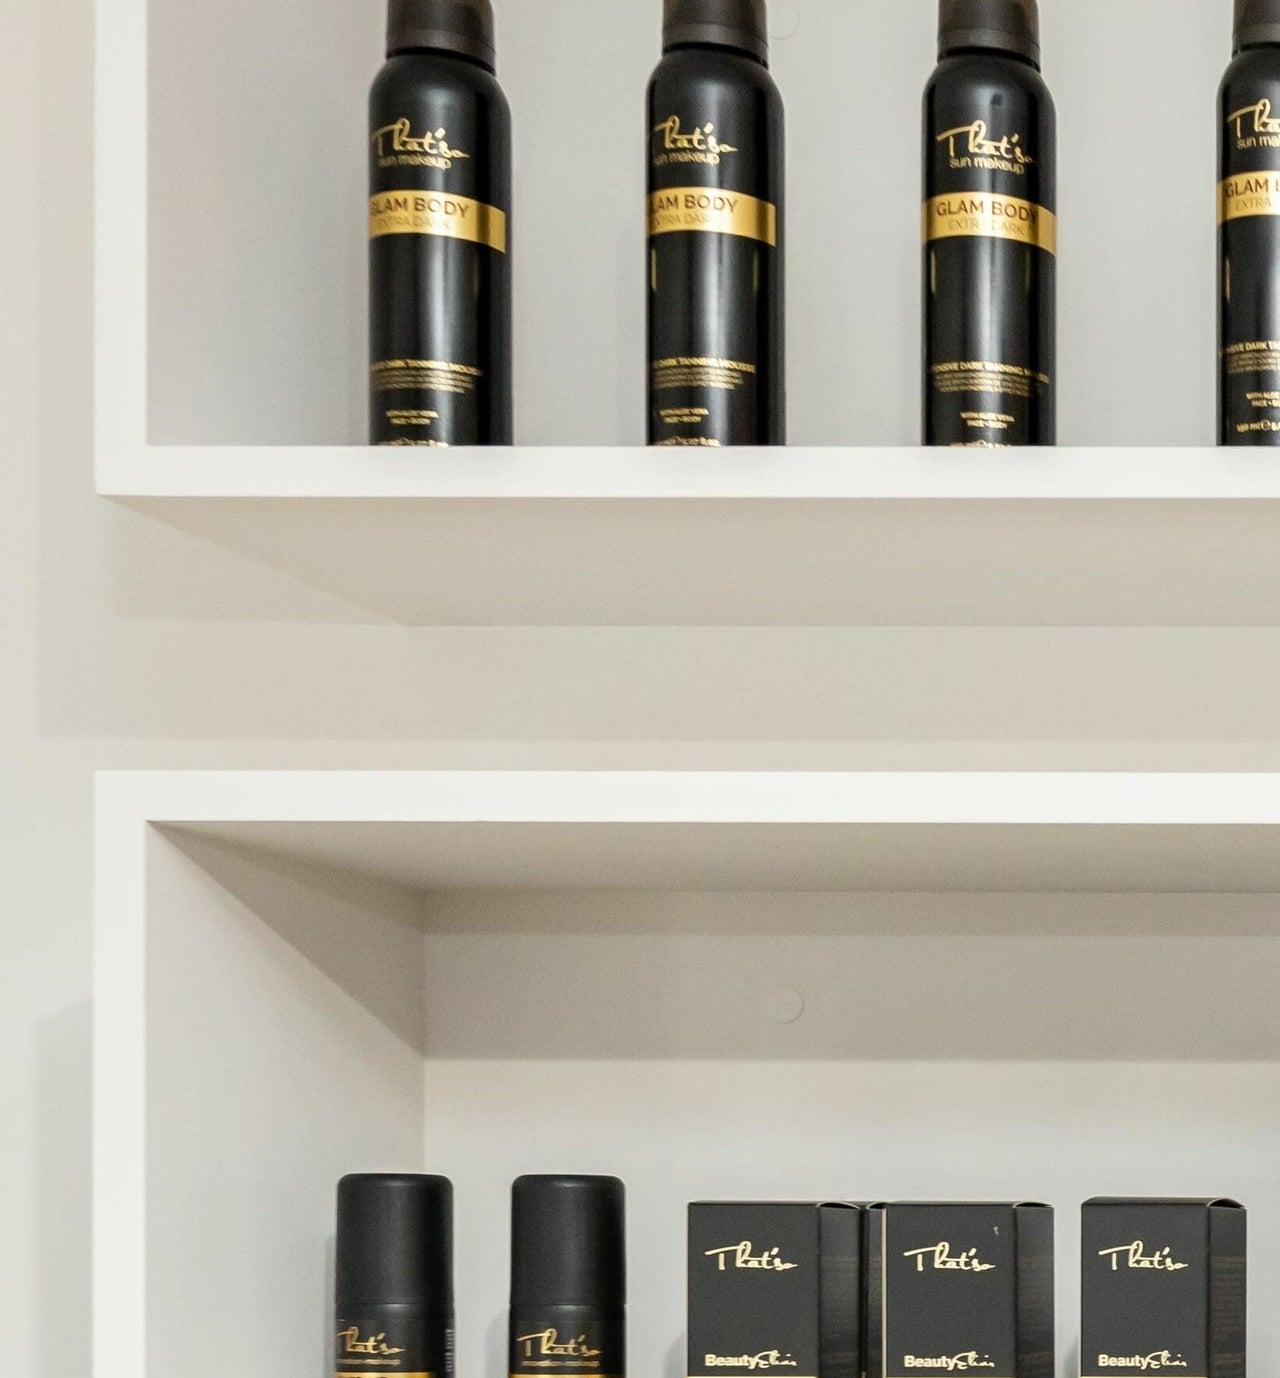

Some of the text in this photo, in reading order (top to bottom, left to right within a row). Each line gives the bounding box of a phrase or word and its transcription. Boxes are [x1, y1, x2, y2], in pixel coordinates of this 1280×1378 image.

[1225, 178, 1268, 197] GLAM
[414, 197, 470, 217] BODY
[684, 195, 738, 213] BODY
[936, 199, 1038, 222] GLAM BODY
